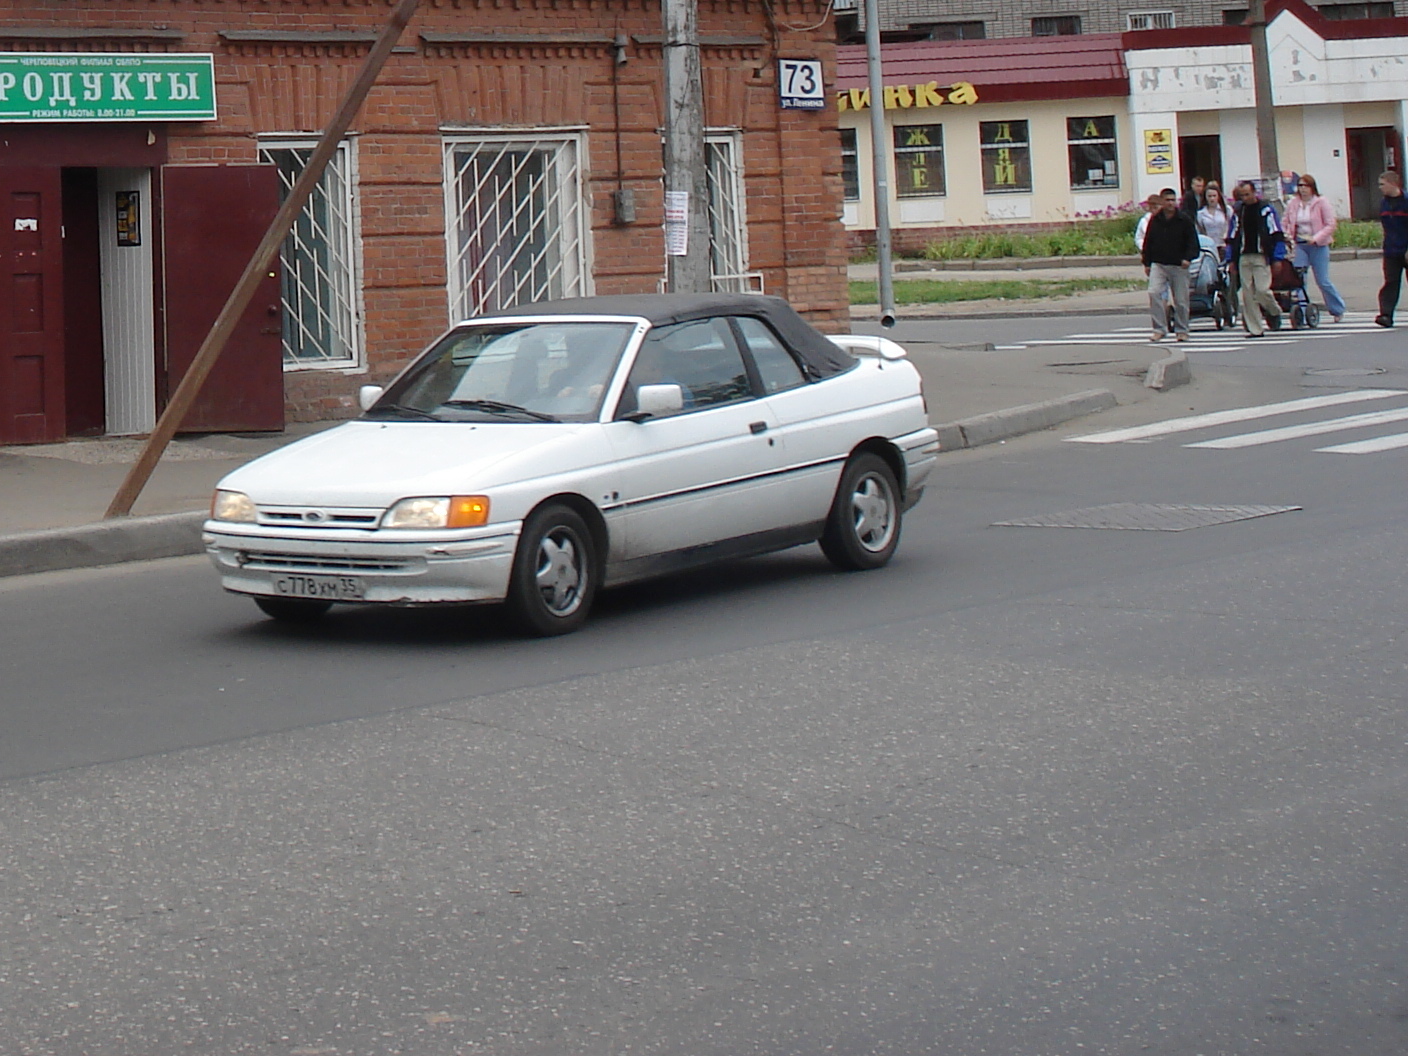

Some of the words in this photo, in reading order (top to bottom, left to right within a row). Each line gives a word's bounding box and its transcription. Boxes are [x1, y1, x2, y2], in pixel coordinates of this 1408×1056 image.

[19, 57, 78, 68] ЧЕРЕПОВЕЦКИЙ
[784, 63, 817, 95] 73
[32, 109, 61, 118] РЕЖИМ
